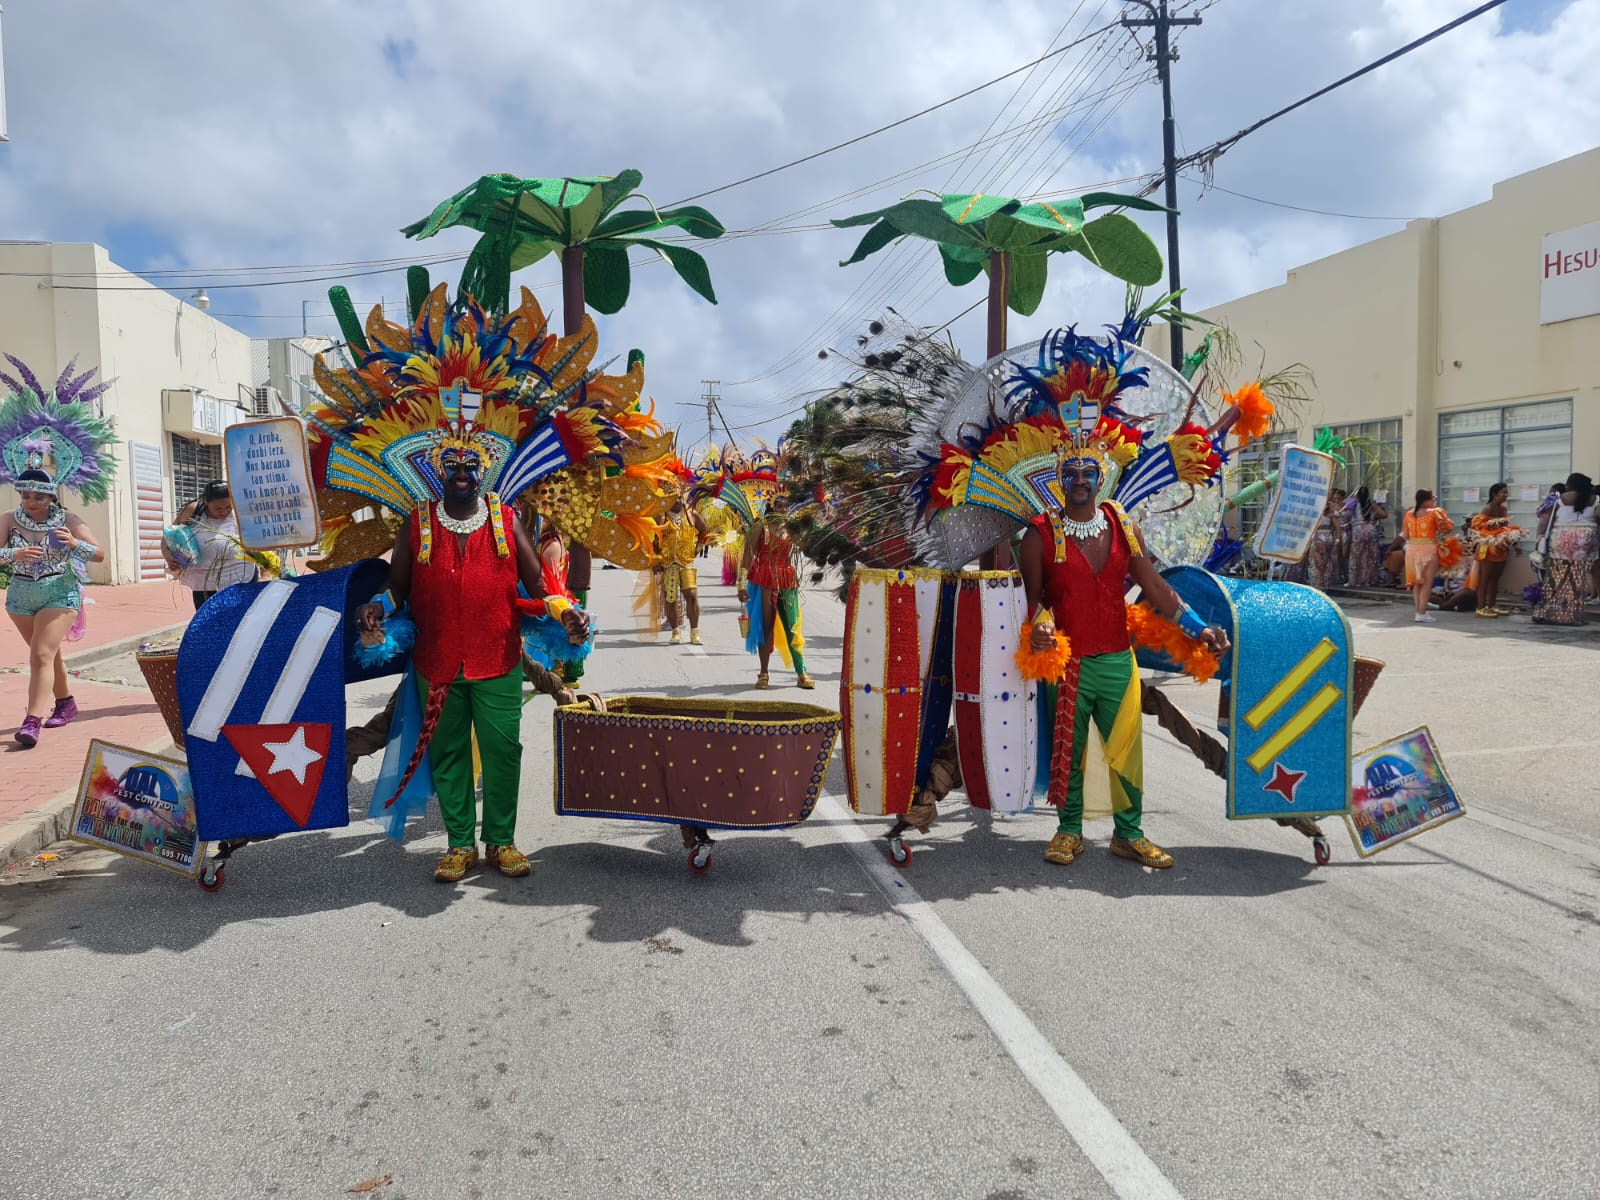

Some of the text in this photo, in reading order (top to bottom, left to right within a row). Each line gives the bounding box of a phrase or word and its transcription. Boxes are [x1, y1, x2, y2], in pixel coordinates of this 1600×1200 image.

[1544, 247, 1600, 279] HESU
[258, 432, 282, 445] Aruba,
[247, 446, 267, 459] dushi
[245, 459, 290, 472] Nos baranca
[251, 474, 262, 485] tan
[243, 487, 257, 499] Nos
[259, 486, 278, 498] Amor
[277, 496, 301, 511] grandi
[283, 511, 302, 521] nada
[262, 528, 271, 538] pa
